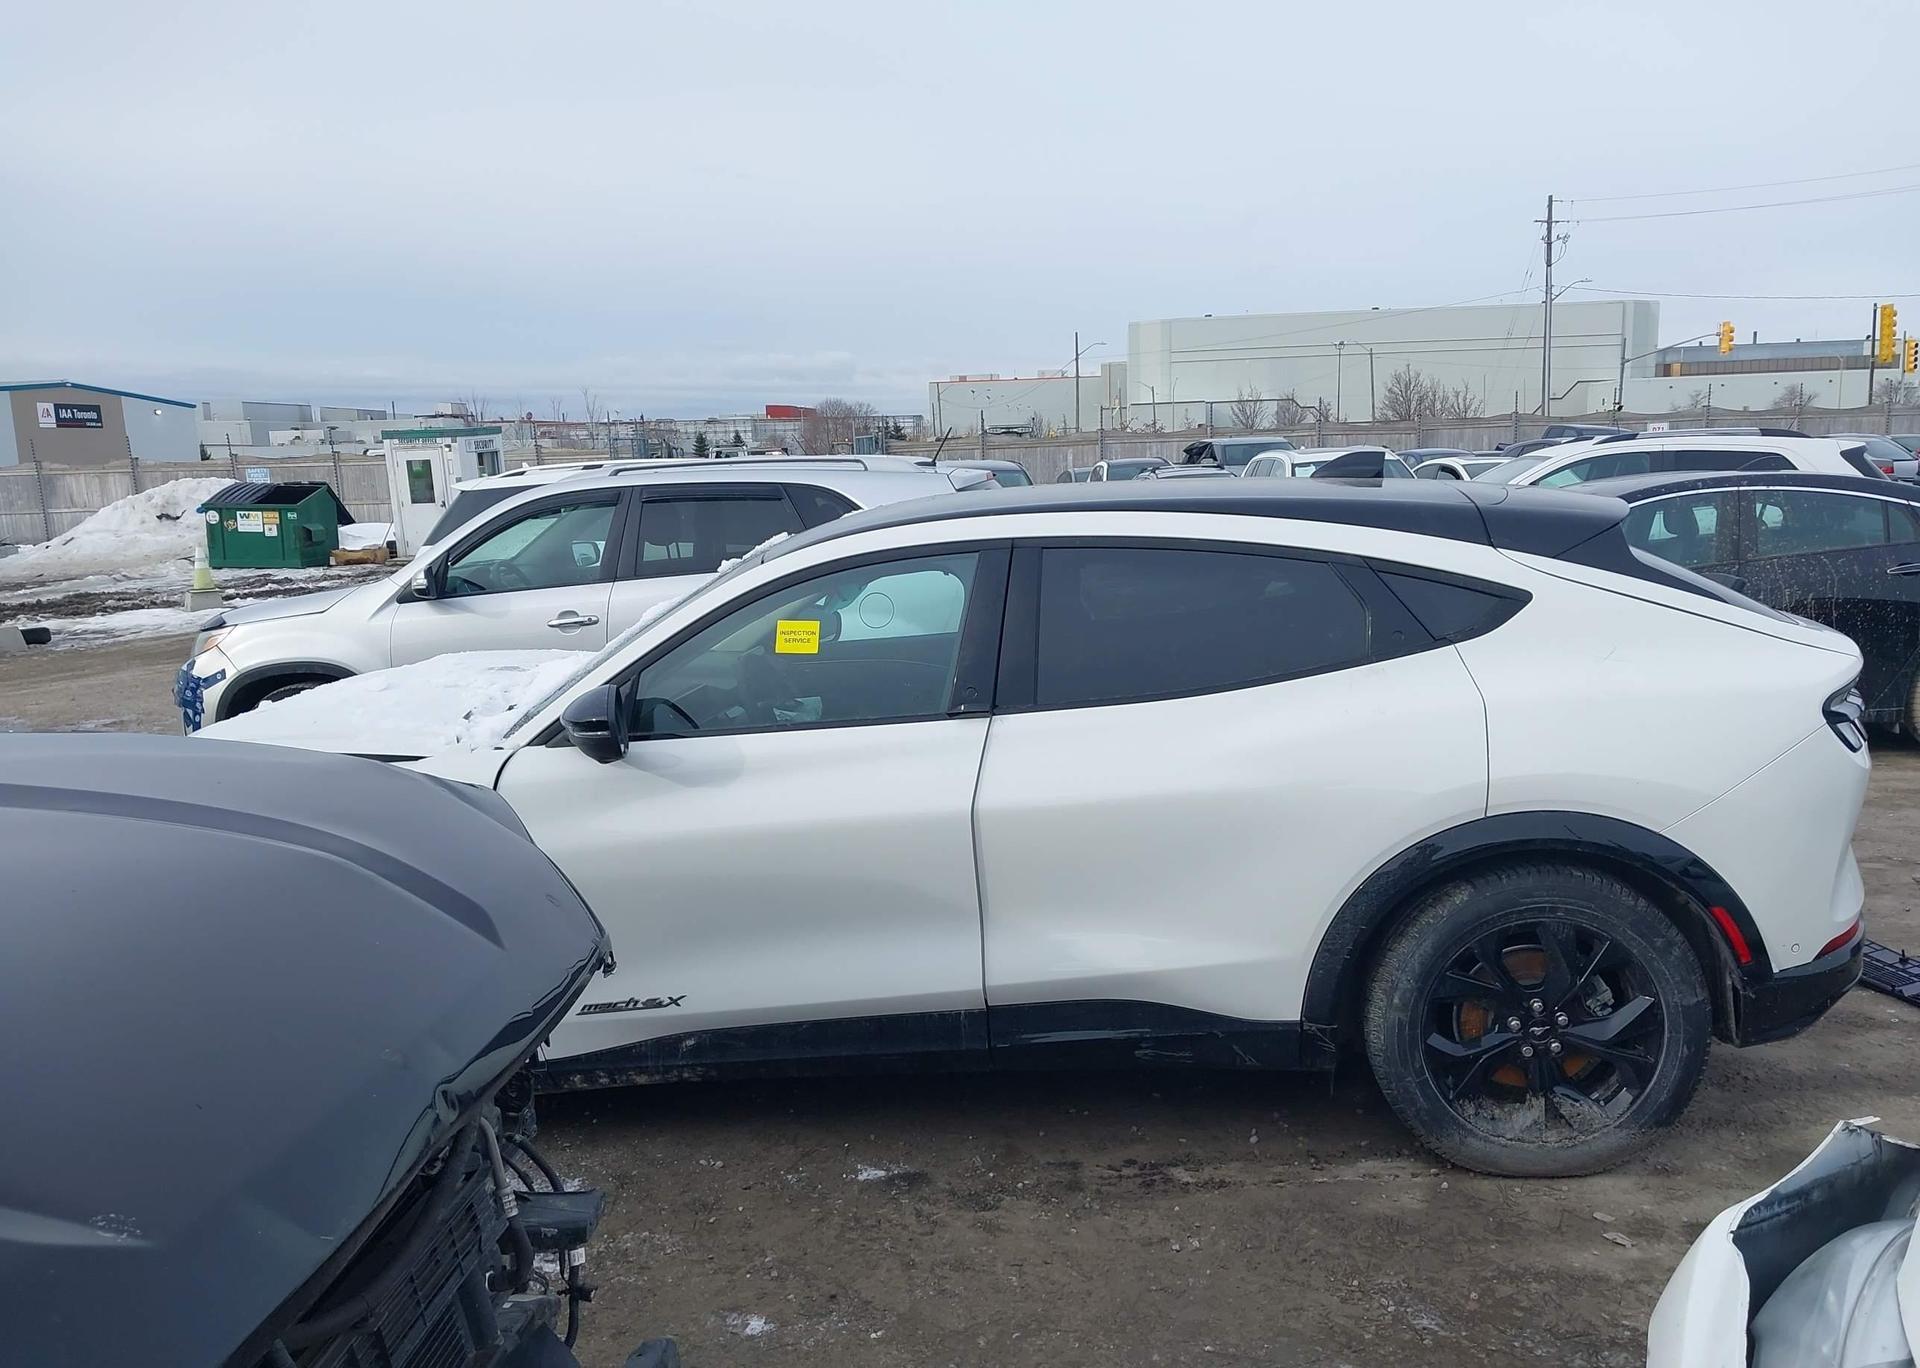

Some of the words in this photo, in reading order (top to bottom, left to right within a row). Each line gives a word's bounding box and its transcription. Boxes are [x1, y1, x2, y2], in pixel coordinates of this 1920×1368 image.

[59, 408, 73, 419] IAA
[73, 409, 98, 420] Toronto
[474, 440, 494, 449] SECURITY
